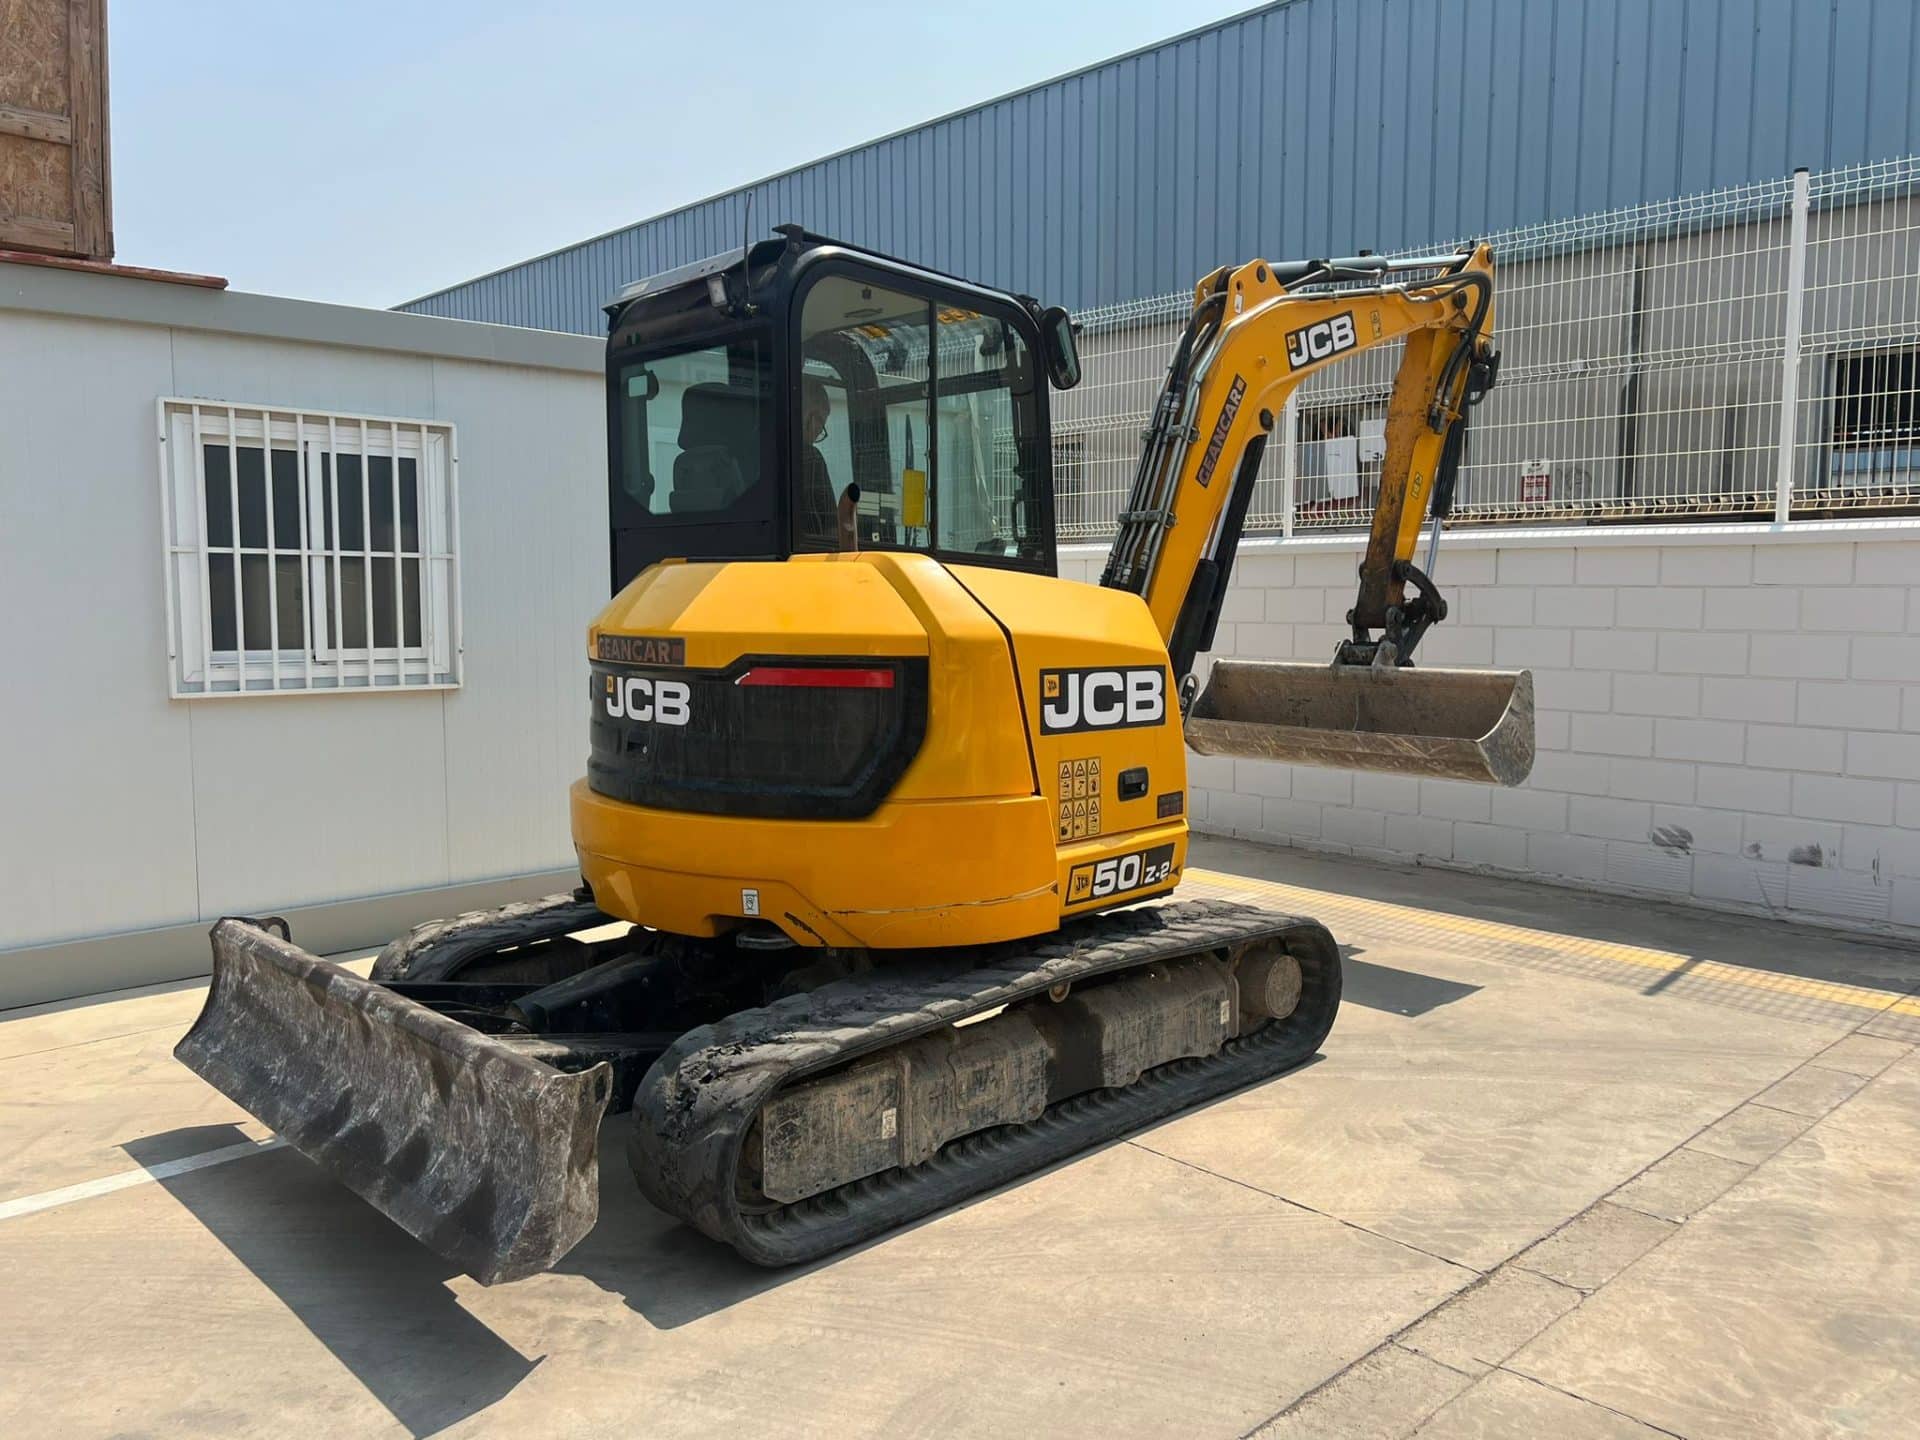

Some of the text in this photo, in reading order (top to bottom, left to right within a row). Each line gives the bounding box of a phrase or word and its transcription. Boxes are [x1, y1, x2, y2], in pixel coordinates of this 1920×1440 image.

[1289, 314, 1356, 367] JCB
[1197, 388, 1242, 486] GEANCAR
[598, 636, 671, 663] GEANCAR
[606, 676, 691, 726] JCB
[1043, 670, 1164, 729] JCB
[1092, 854, 1141, 896] 50
